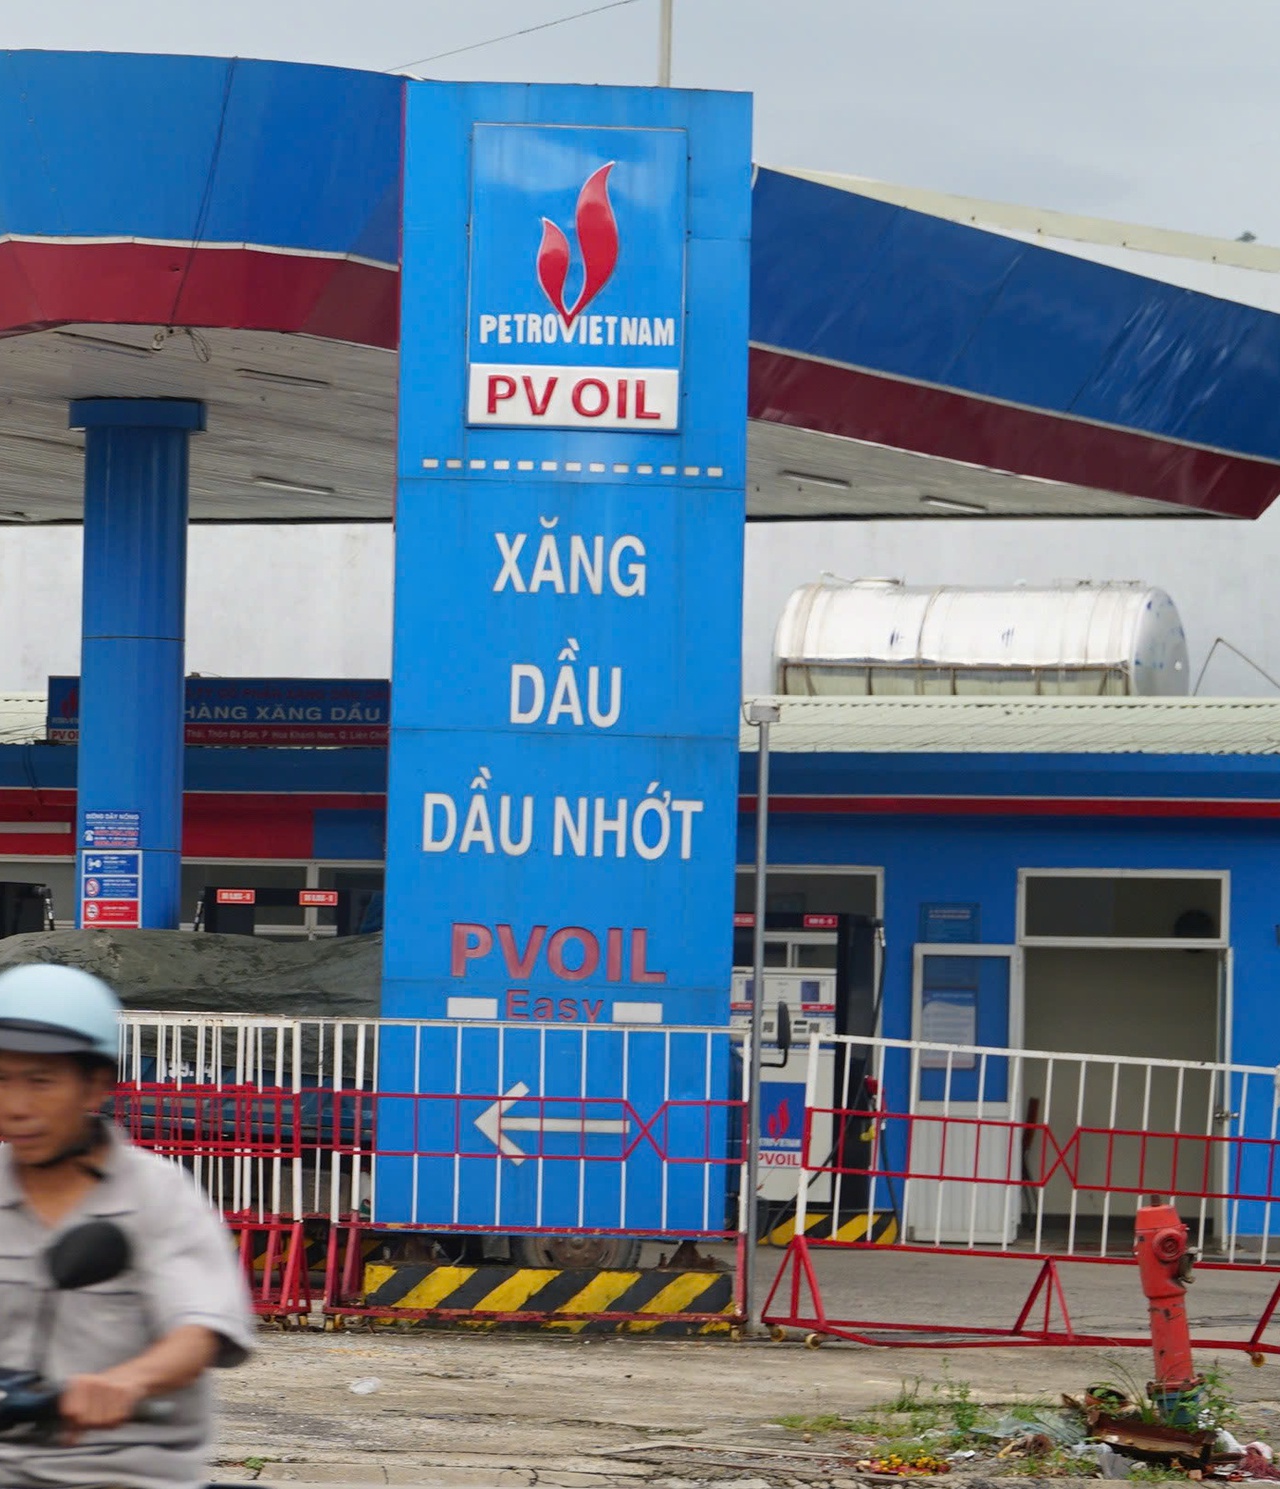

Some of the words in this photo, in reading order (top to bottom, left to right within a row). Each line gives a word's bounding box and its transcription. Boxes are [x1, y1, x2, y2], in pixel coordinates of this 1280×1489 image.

[479, 313, 675, 346] PETROVIETNAM
[487, 374, 559, 416] PV
[571, 377, 662, 420] OIL
[492, 516, 647, 598] XĂNG
[509, 637, 623, 728] DẦU
[256, 703, 323, 721] XĂNG
[422, 766, 535, 857] DẦU
[552, 781, 705, 861] NHỚT
[450, 922, 667, 984] PVOIL
[505, 988, 604, 1024] Easy
